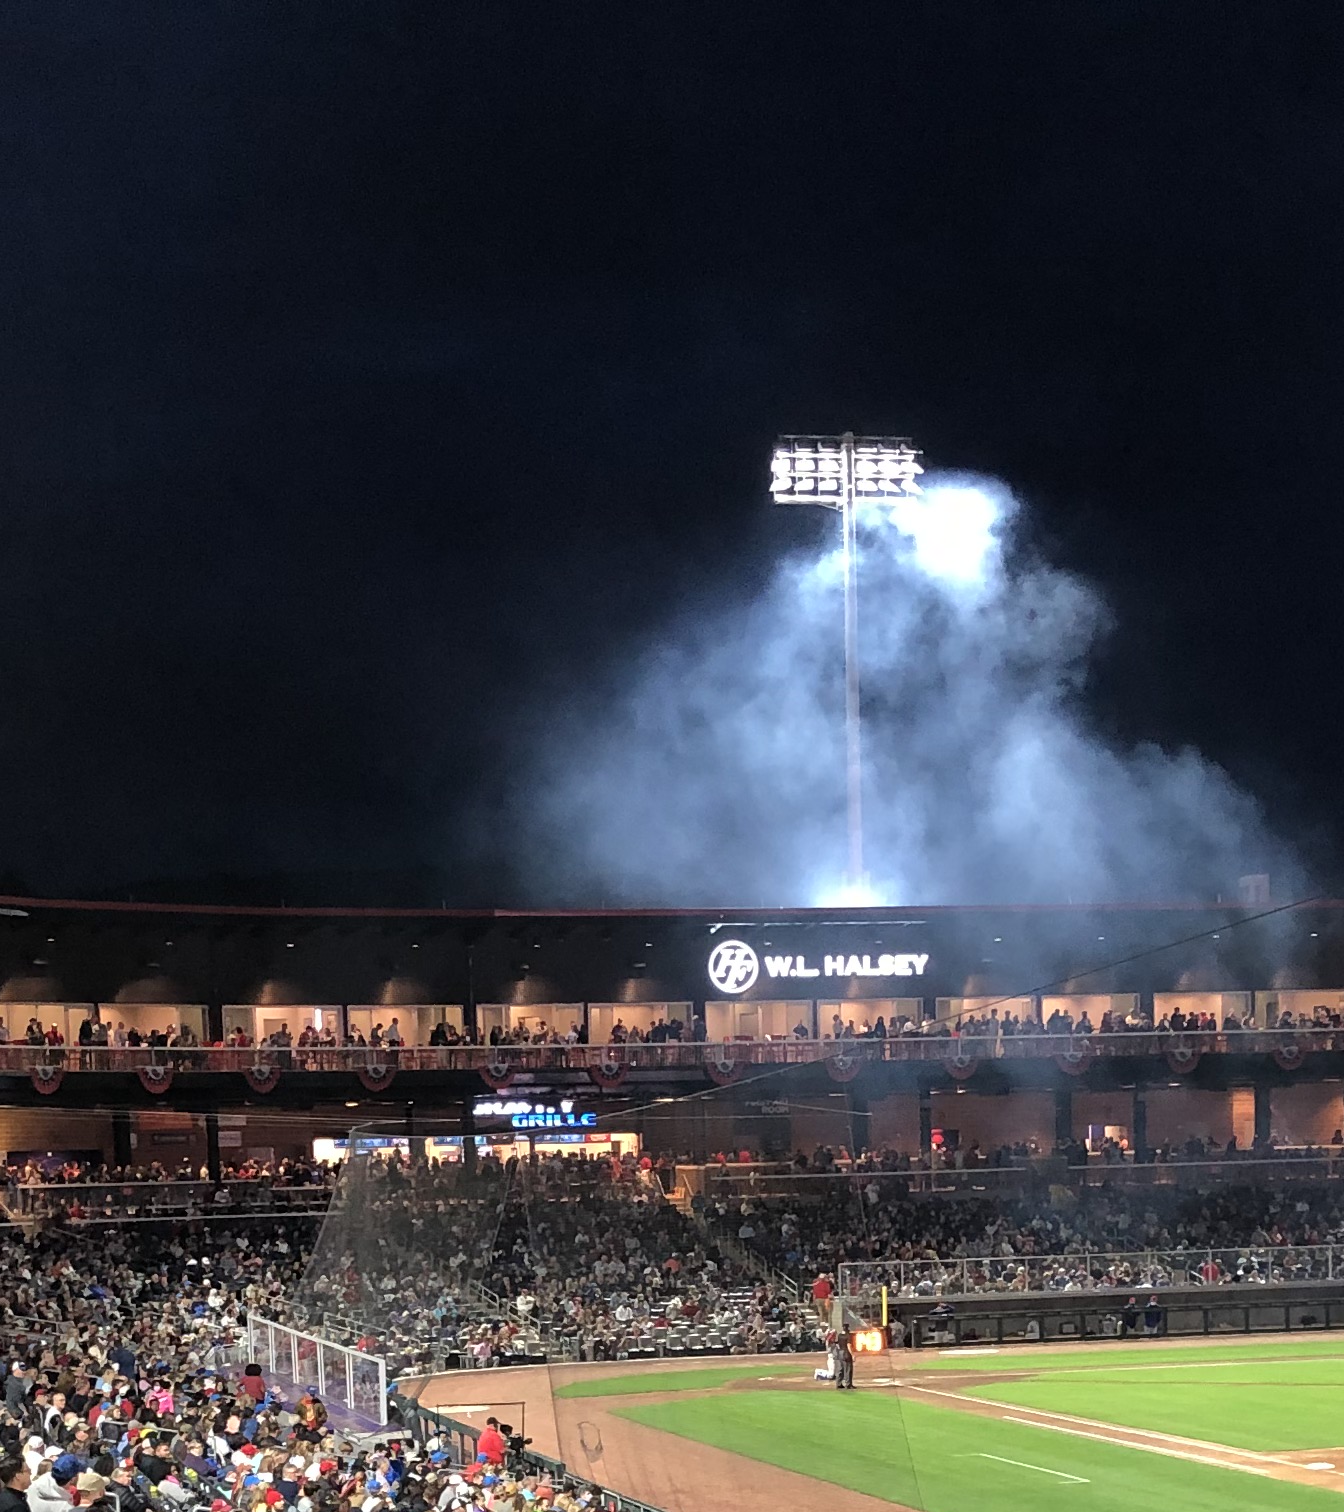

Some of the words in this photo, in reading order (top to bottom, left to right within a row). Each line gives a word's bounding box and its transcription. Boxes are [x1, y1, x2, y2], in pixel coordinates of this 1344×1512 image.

[764, 956, 820, 977] W.L.
[824, 954, 929, 976] HALSEY
[512, 1112, 597, 1128] GRILLE
